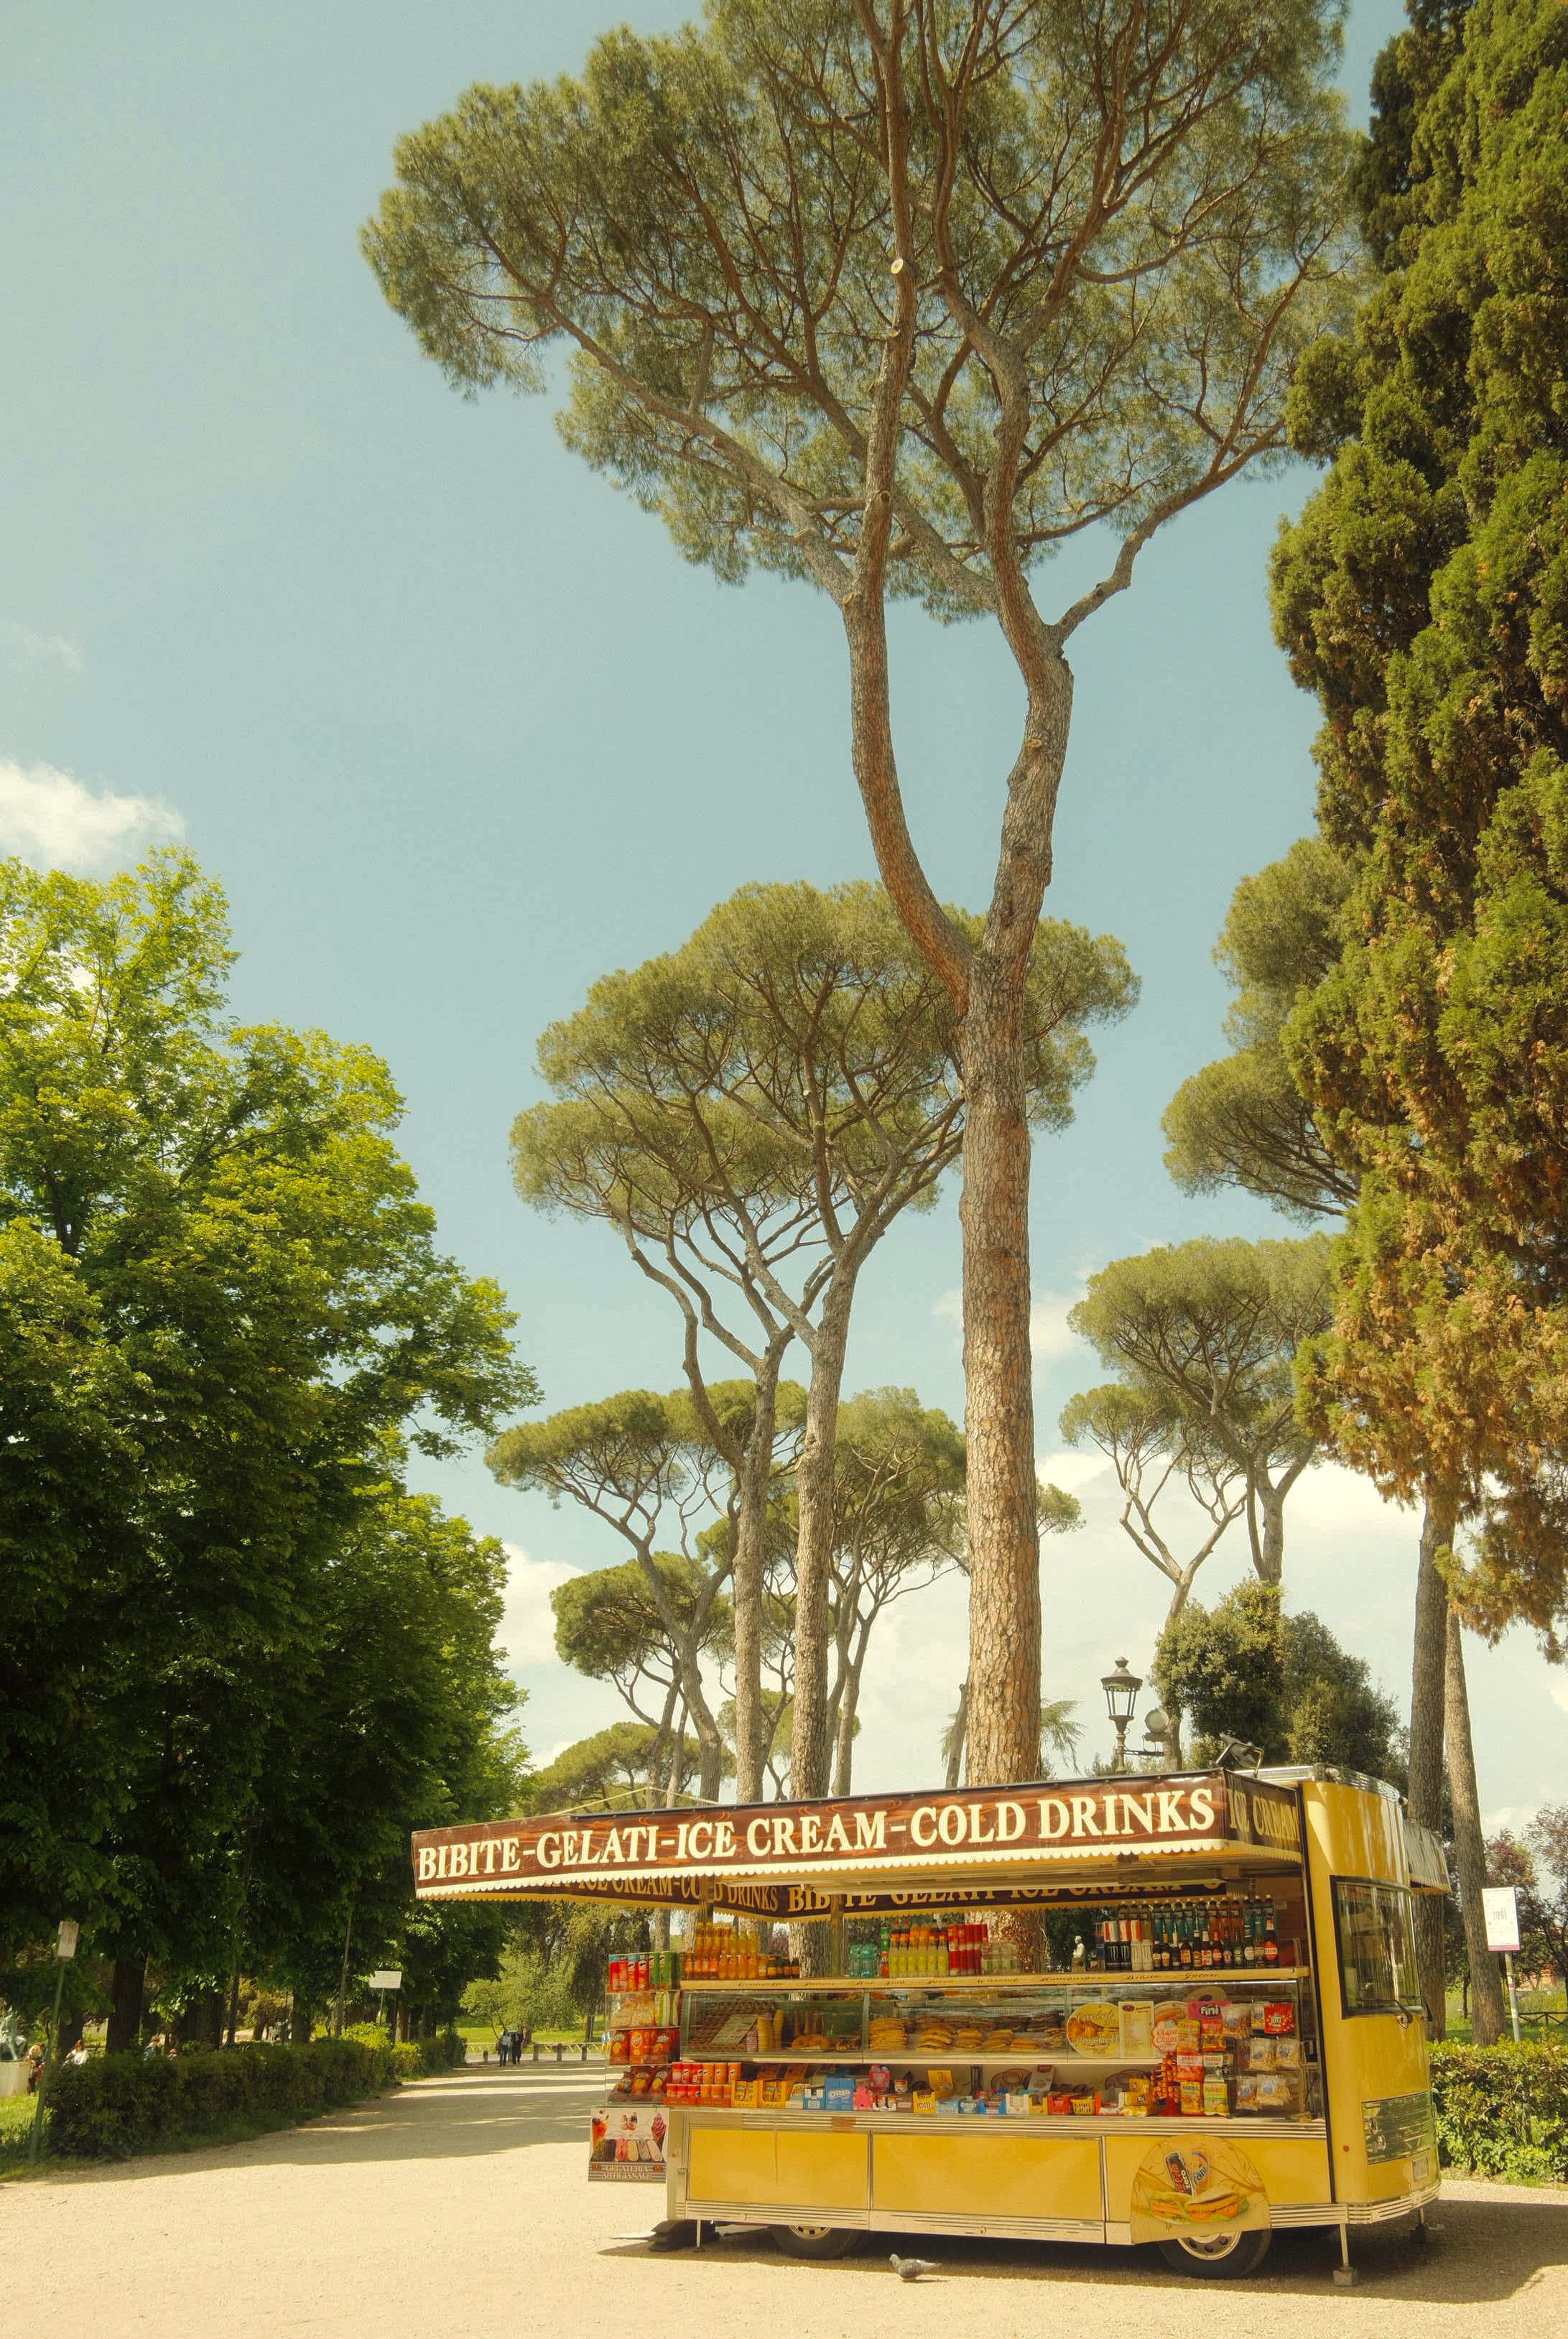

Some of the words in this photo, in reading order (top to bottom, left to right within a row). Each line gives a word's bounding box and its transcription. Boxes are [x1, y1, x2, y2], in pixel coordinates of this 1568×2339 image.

[1037, 1788, 1215, 1839] DRINKS
[1227, 1788, 1250, 1833] ICE
[727, 1885, 779, 1912] DRINKS
